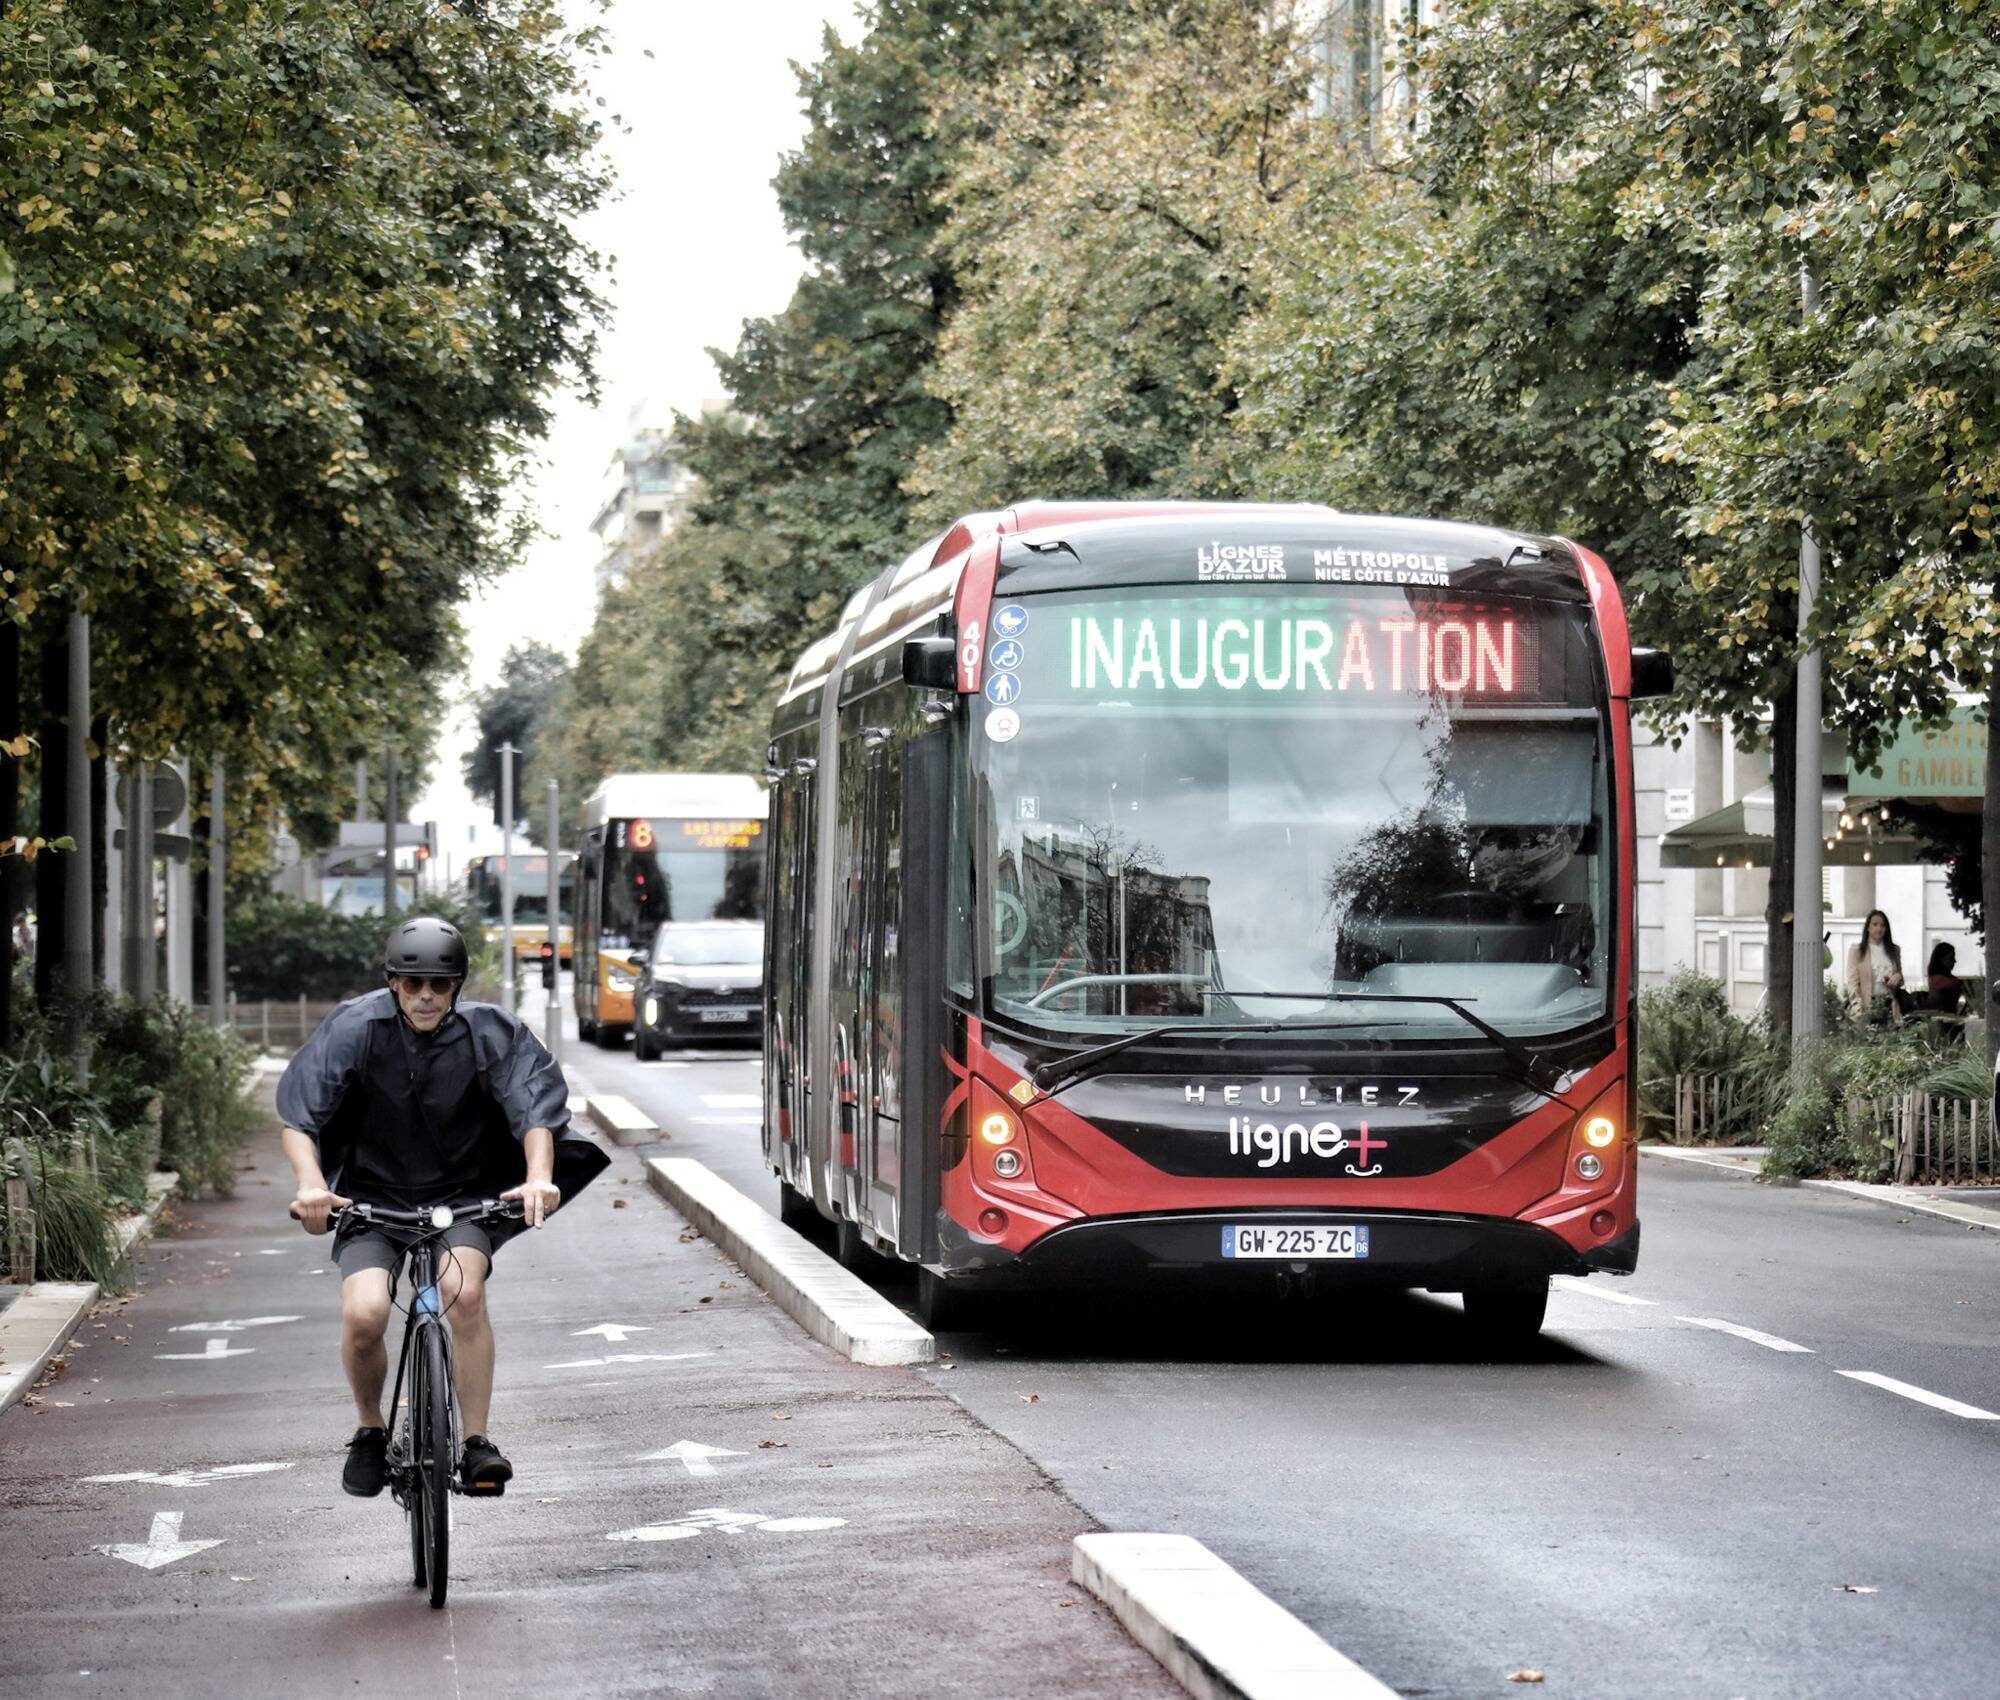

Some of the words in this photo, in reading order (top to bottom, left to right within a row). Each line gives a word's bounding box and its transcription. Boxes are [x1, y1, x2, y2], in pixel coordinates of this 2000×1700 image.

[1313, 546, 1449, 572] MÉTROPOLE
[1315, 568, 1351, 581] NICE
[1354, 567, 1393, 582] CÔTE
[1397, 570, 1450, 586] D'AZUR
[955, 621, 980, 690] 401
[1070, 618, 1514, 692] INAUGURATION
[632, 820, 654, 848] 8
[1184, 1085, 1420, 1107] HEULIEZ
[1239, 1230, 1352, 1253] GW-225-ZC
[1356, 1242, 1369, 1253] 06
